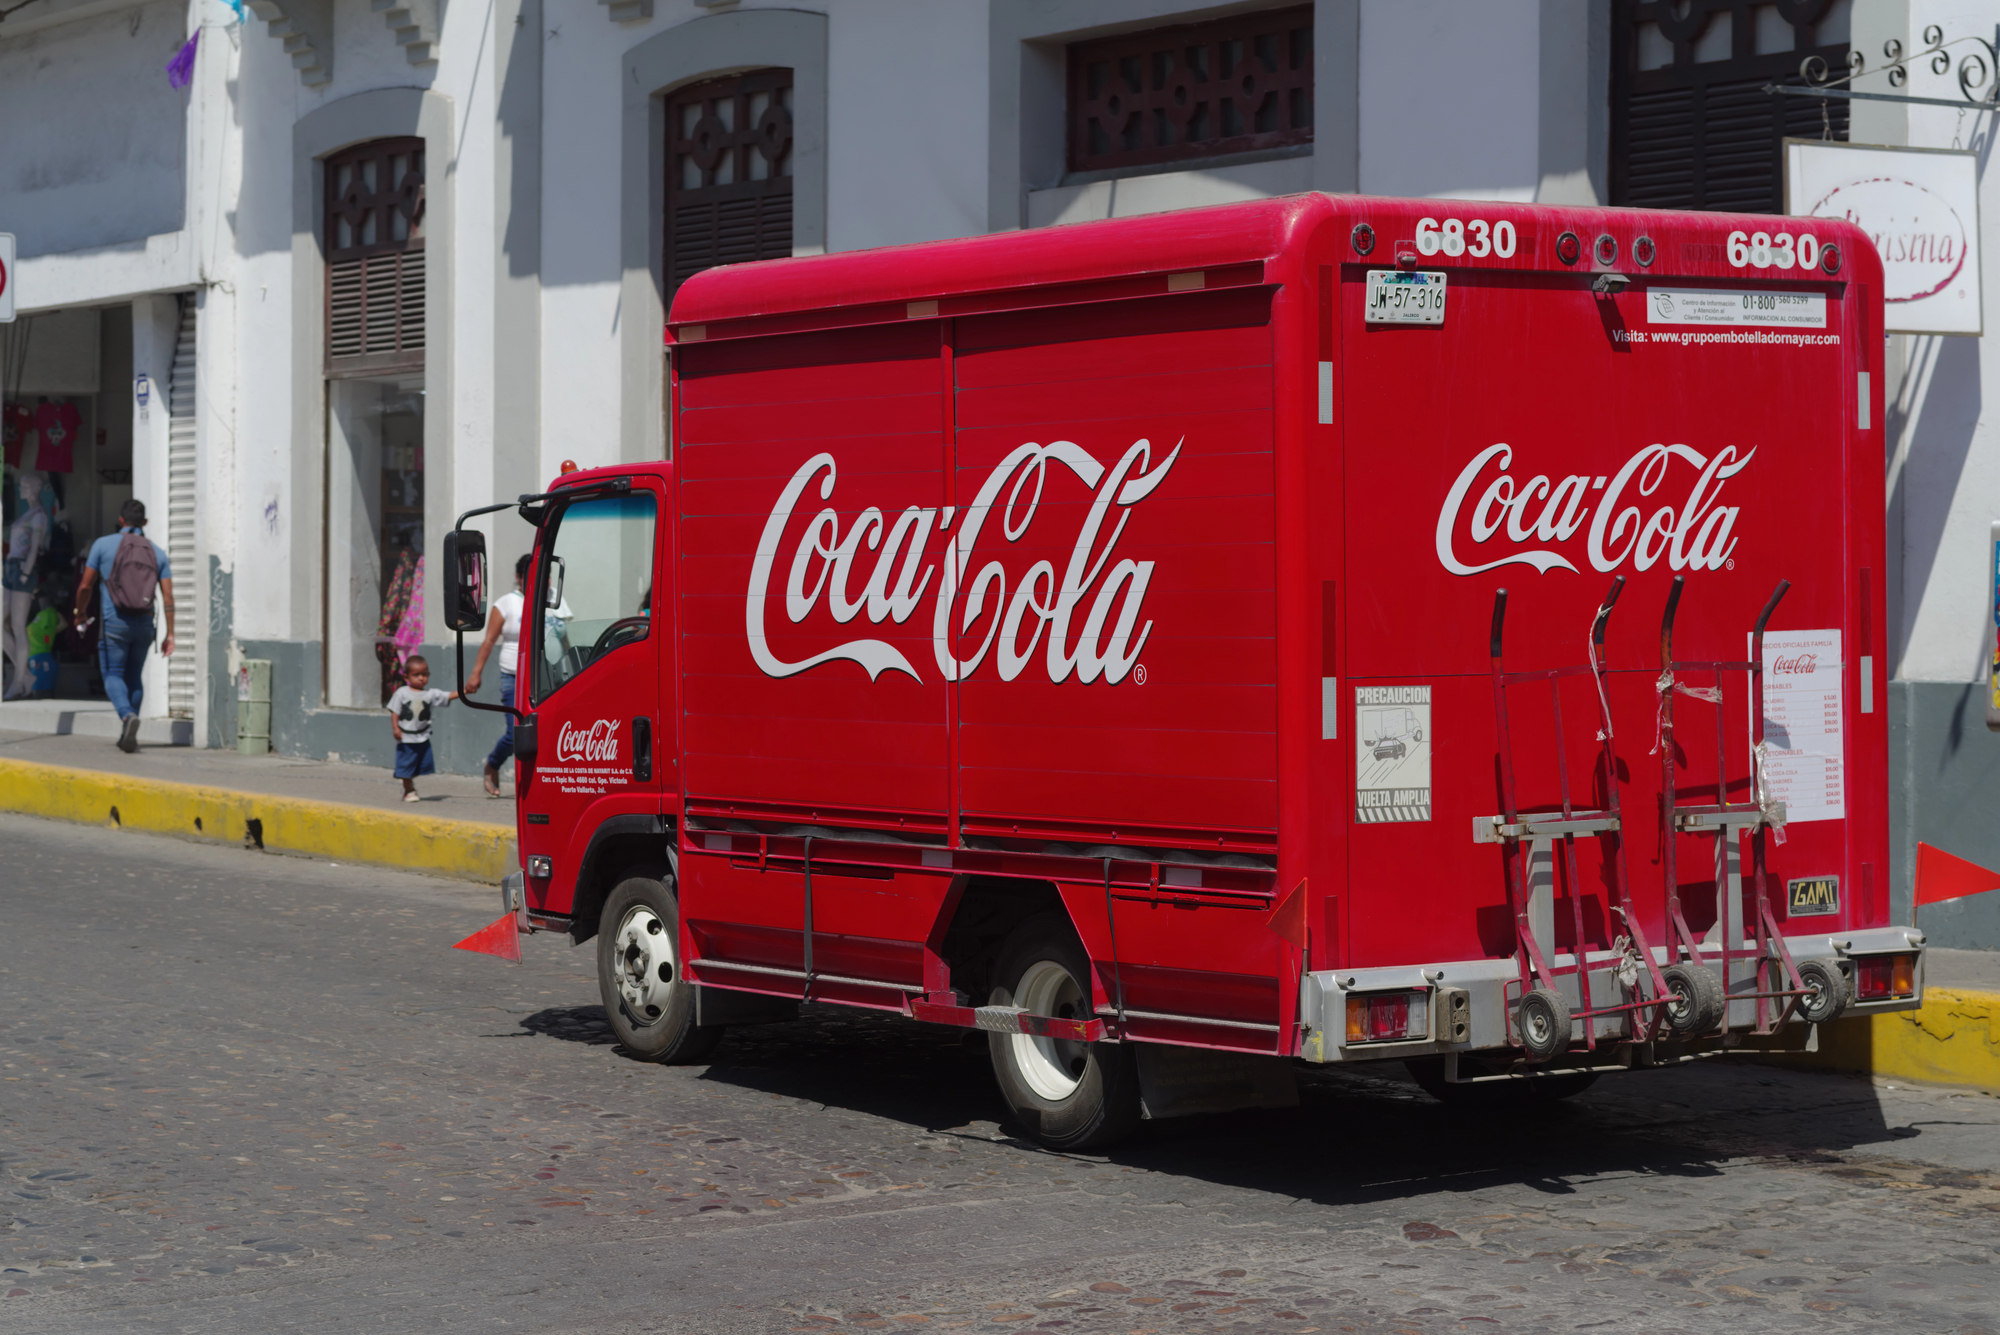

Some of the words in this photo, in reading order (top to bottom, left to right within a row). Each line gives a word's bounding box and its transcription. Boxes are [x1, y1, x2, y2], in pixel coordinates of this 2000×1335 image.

[1416, 217, 1517, 259] 6830
[1727, 230, 1819, 271] 6830
[1370, 285, 1443, 310] JW-57-316
[1706, 299, 1736, 307] Información
[1704, 314, 1735, 322] Consumidor
[1742, 314, 1780, 322] INFORMACION
[1612, 329, 1648, 342] Visita:
[1651, 330, 1841, 348] www.grupoembotelladornayar.com
[1762, 642, 1782, 650] RECIOS
[1782, 641, 1811, 649] OFICIALES
[1811, 640, 1833, 648] FAMILIA
[1356, 687, 1430, 704] PRECAUCION
[1763, 683, 1793, 691] ORNABLES
[1357, 790, 1391, 807] VUELTA
[1393, 789, 1430, 806] AMPLIA
